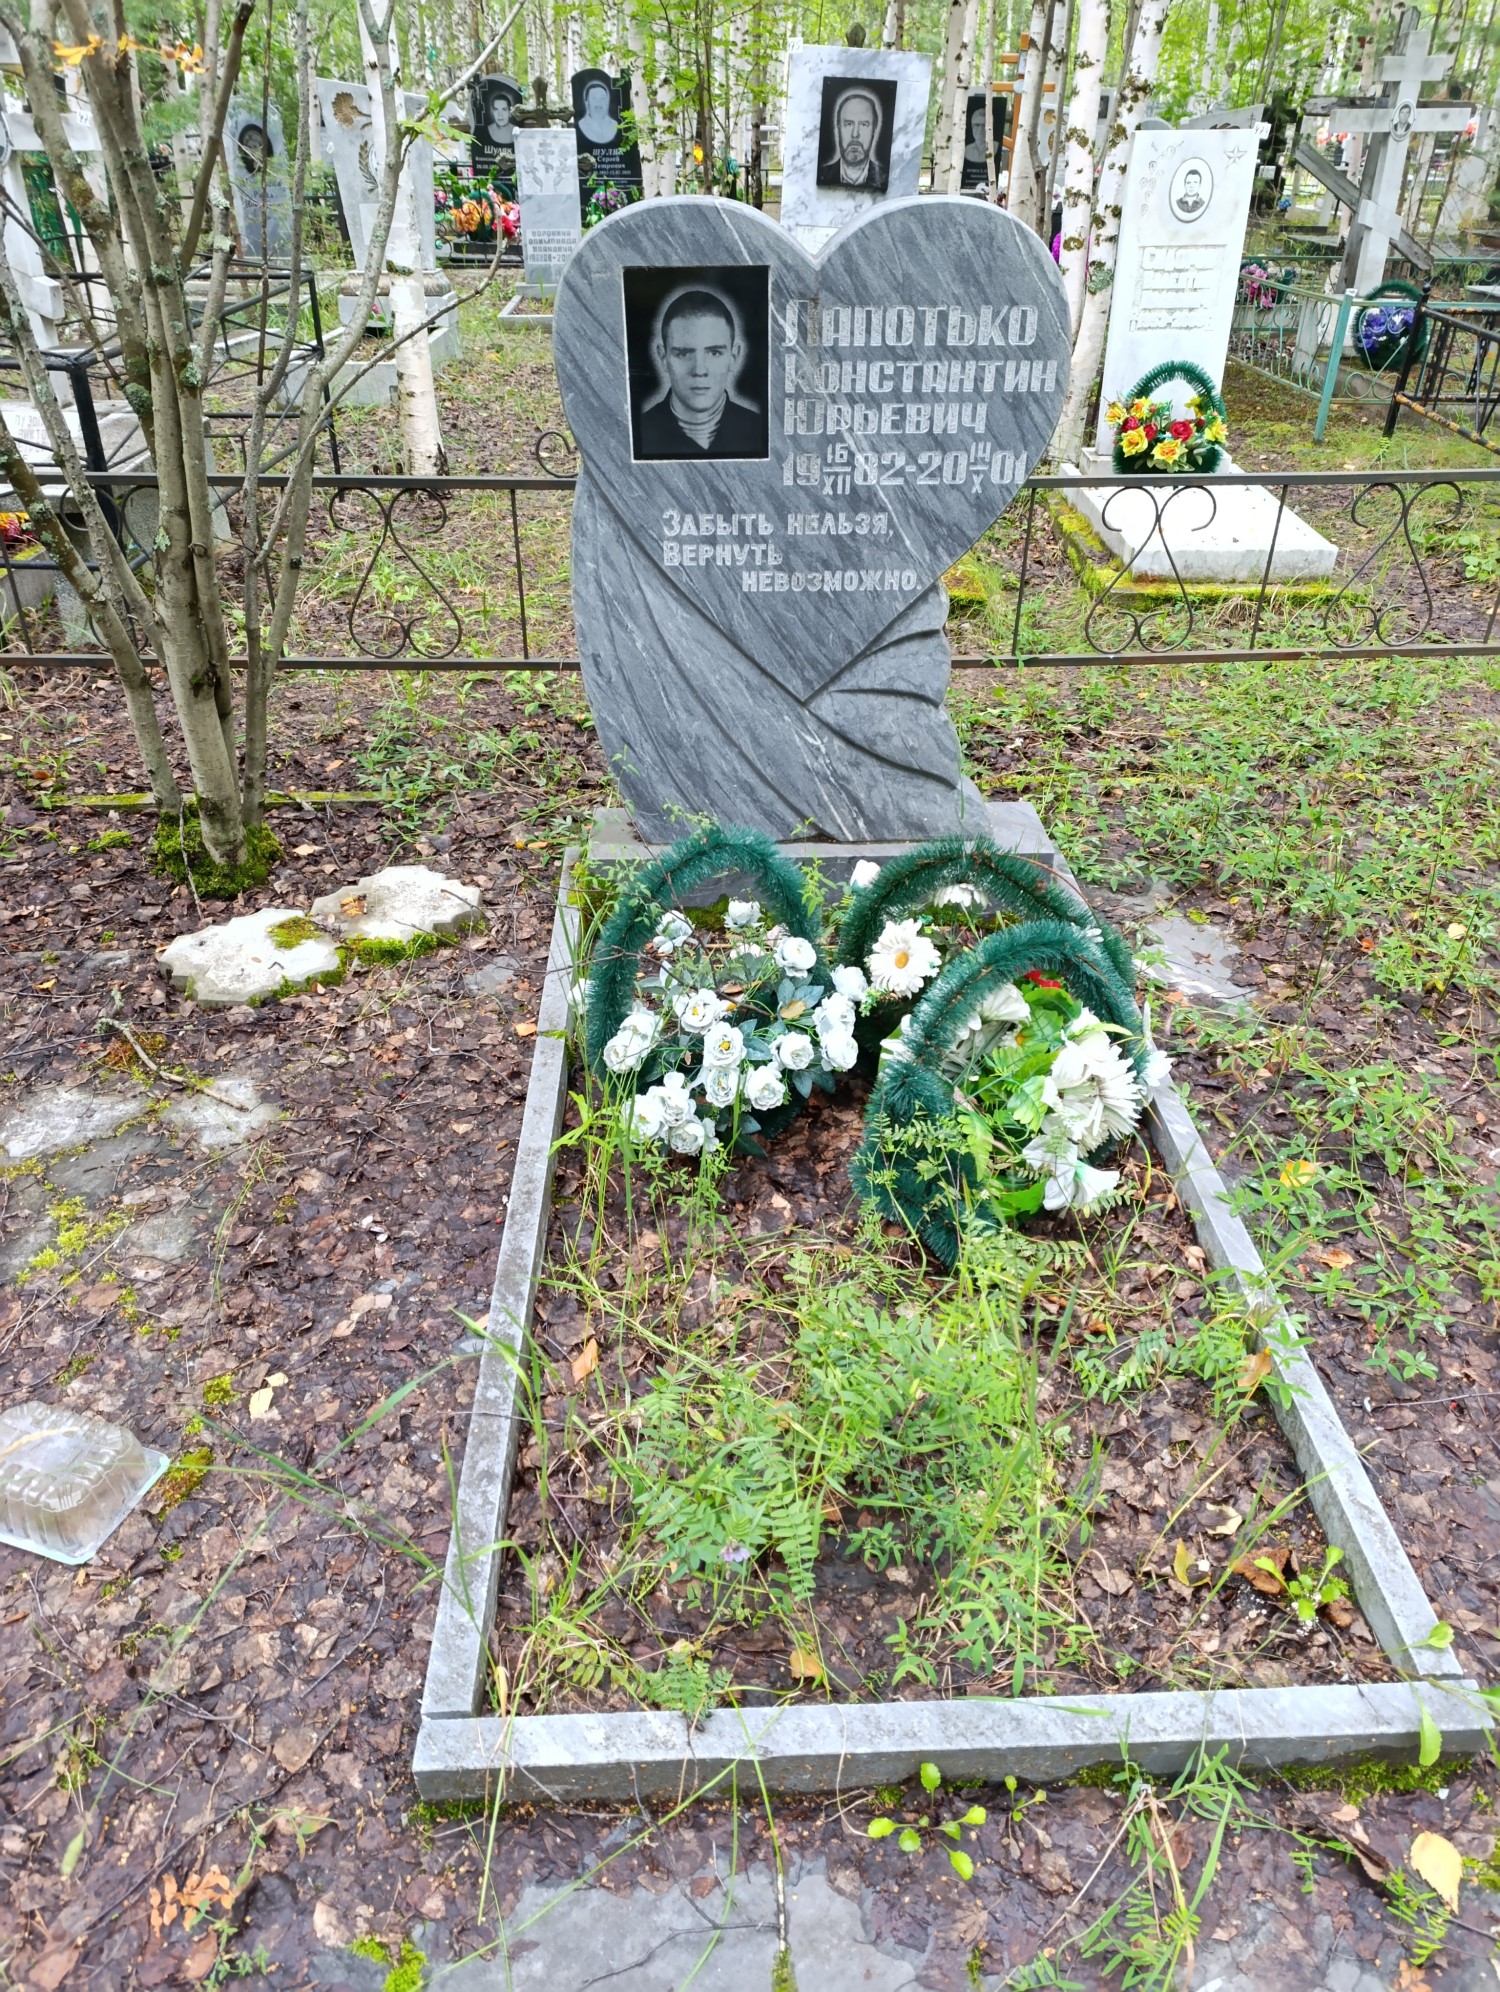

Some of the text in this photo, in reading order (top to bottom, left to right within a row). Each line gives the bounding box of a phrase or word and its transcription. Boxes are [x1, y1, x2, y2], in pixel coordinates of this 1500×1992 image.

[781, 299, 1038, 346] ЛАПОТЬКО
[784, 353, 1058, 393] КОНСТАНТИН
[783, 398, 988, 435] ЮРЬЕВИЧ
[662, 508, 774, 537] ЗАБЫТЬ
[662, 540, 783, 567] ВЕРНУТЬ
[741, 568, 923, 593] НЕВОЗМОЖНО.
